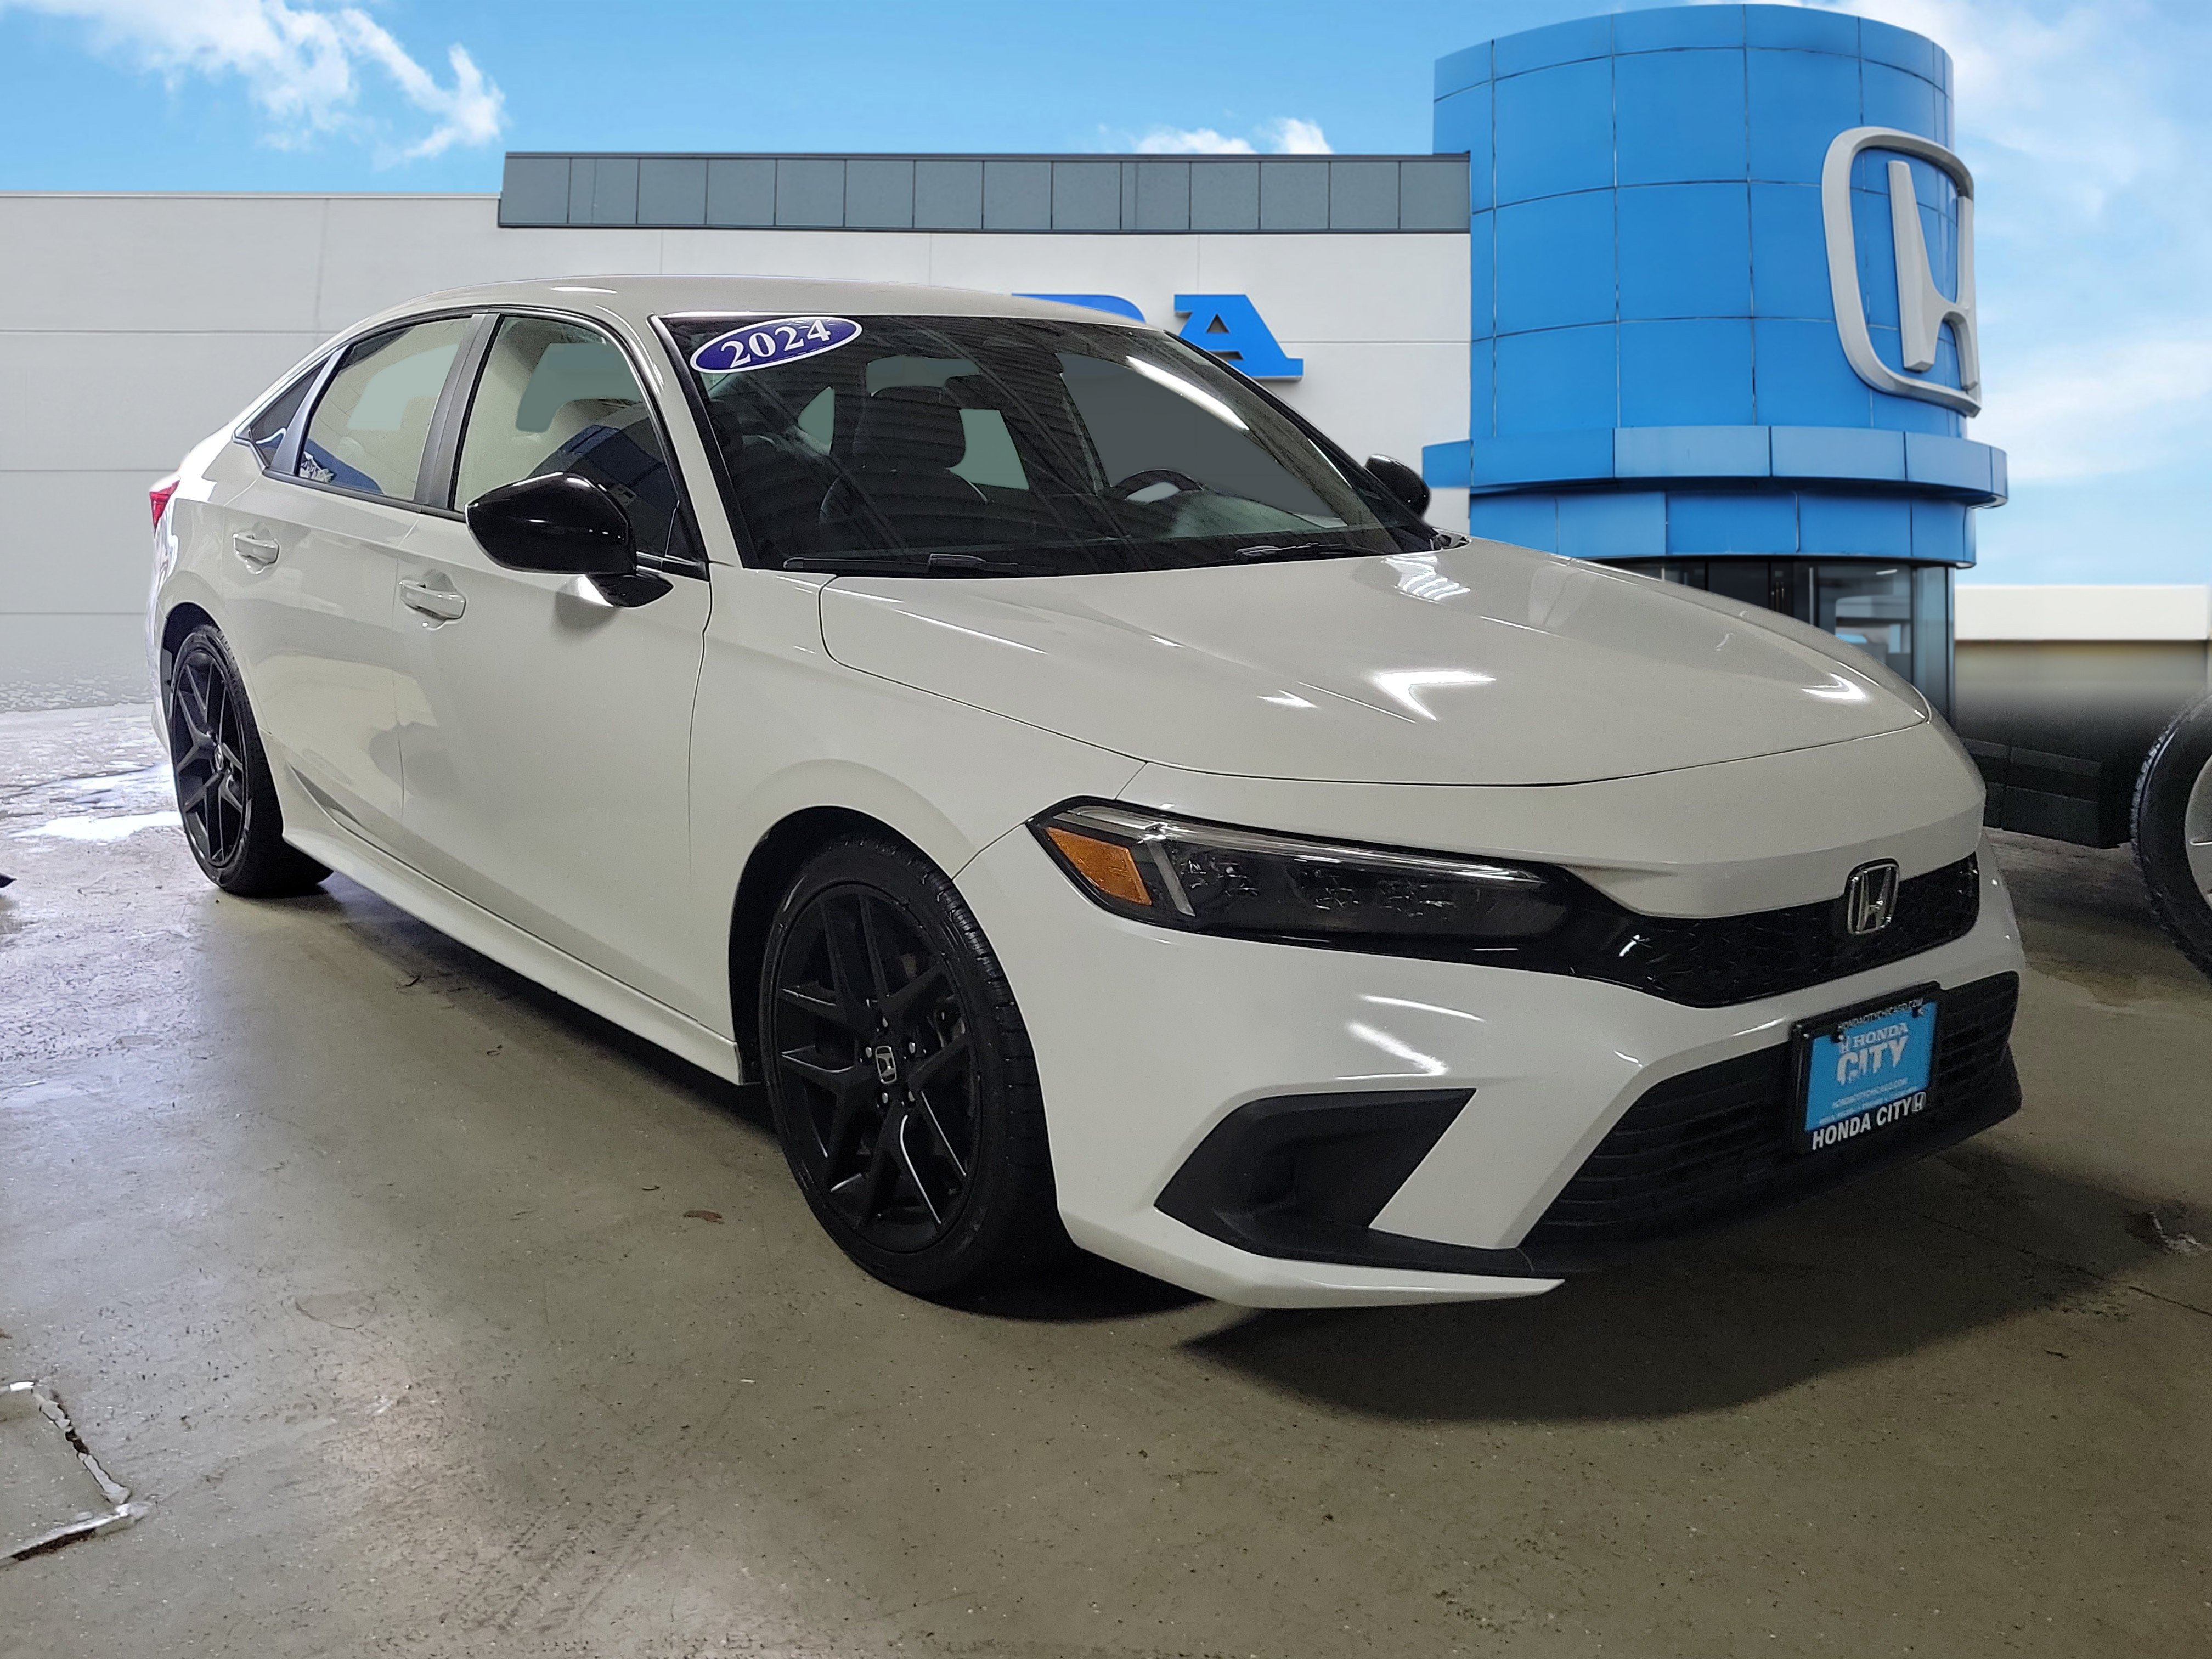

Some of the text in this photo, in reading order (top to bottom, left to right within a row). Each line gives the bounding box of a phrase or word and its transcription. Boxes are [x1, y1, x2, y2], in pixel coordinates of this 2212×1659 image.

[721, 319, 831, 368] 2024
[1853, 1022, 1909, 1047] HONDA
[1837, 1035, 1909, 1086] CITY
[1812, 1113, 1871, 1150] HONDA
[1876, 1097, 1912, 1126] CITY
